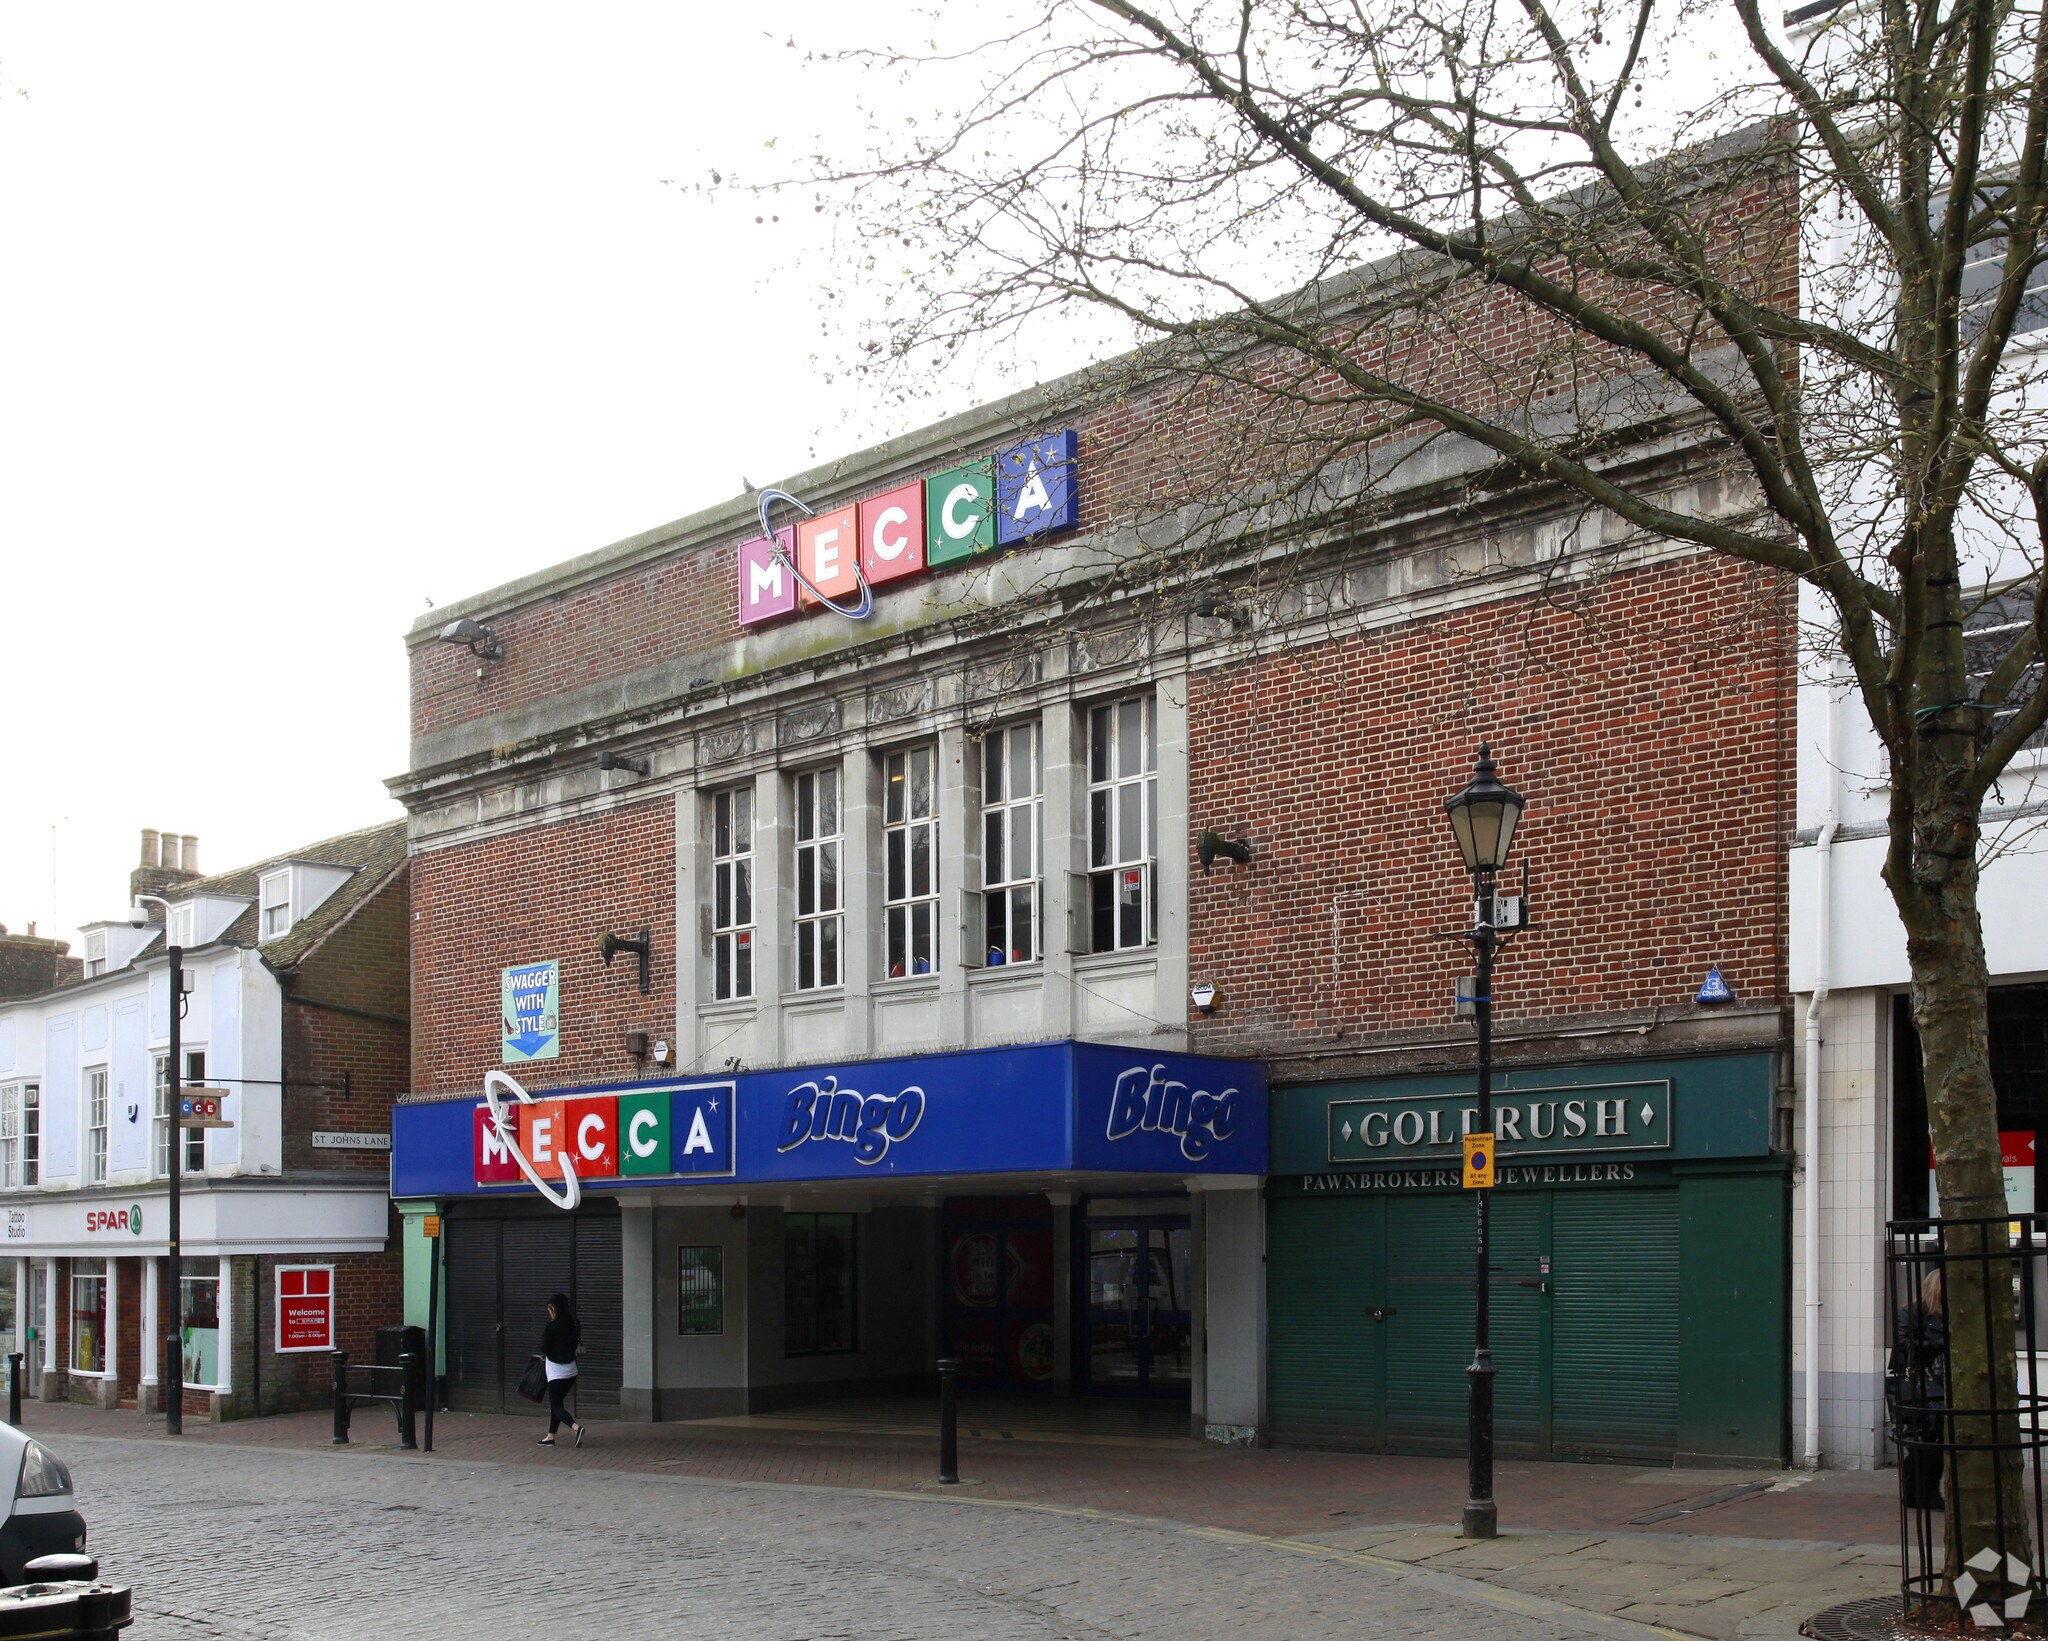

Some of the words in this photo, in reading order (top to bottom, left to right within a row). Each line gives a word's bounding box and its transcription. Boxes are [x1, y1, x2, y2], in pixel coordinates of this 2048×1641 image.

[749, 459, 1053, 607] MECCA
[505, 969, 556, 992] SWAGGER
[515, 992, 544, 1012] WITH
[515, 1014, 545, 1034] STYLE
[777, 1076, 927, 1165] Bingo
[1106, 1063, 1239, 1161] Bingo
[331, 1136, 361, 1144] JOHNS
[364, 1137, 388, 1146] LANE
[482, 1106, 714, 1166] MECCA
[1302, 1169, 1460, 1190] PAWNBROKERS
[1494, 1163, 1635, 1185] JEWELLERS
[8, 1210, 25, 1223] Tattoo
[86, 1210, 129, 1232] SPAR
[7, 1225, 26, 1239] Studio
